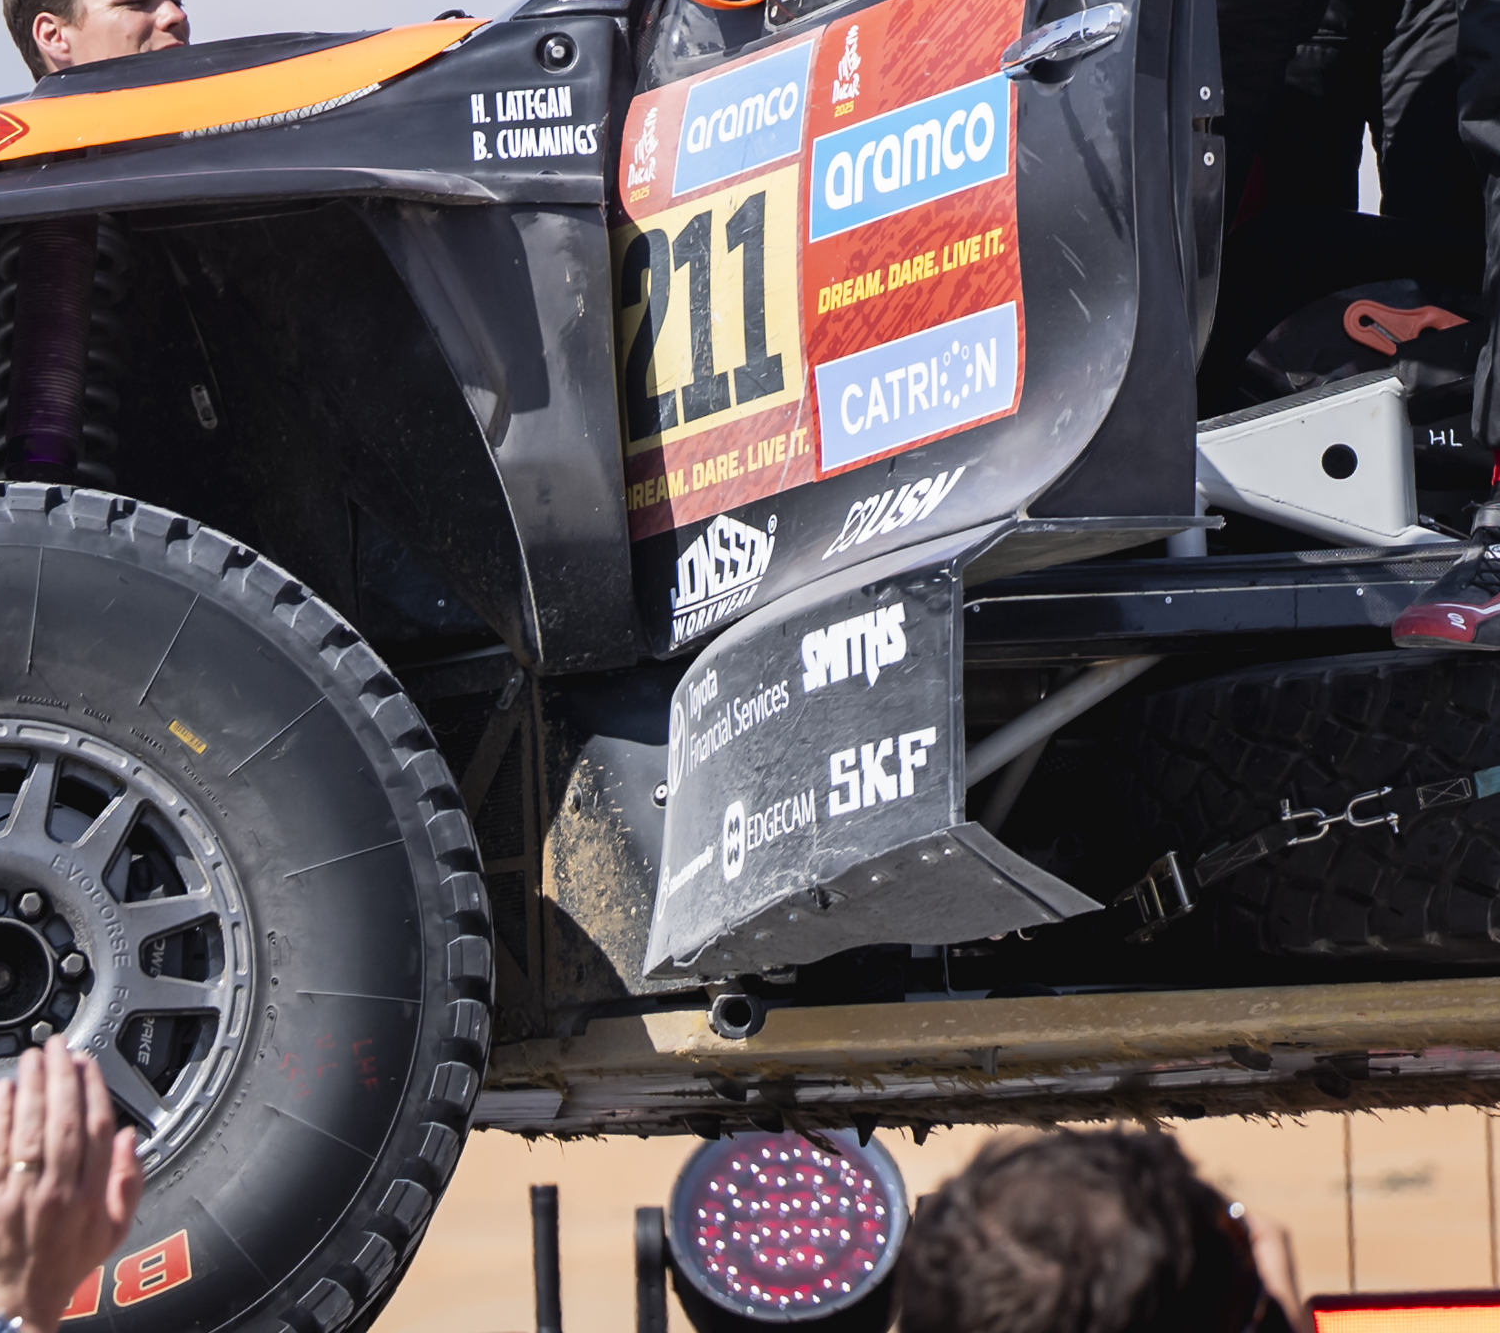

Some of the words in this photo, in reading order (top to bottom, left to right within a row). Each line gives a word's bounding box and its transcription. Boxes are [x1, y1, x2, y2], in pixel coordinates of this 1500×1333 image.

[471, 94, 490, 123] H.
[496, 86, 572, 120] LATEGAN
[686, 82, 799, 154] aramco
[834, 101, 854, 117] 2025
[472, 131, 493, 161] B.
[497, 123, 598, 158] CUMMINGS
[824, 101, 994, 210] aramco
[817, 273, 885, 314] DREAM.
[887, 252, 939, 293] DARE.
[941, 236, 981, 275] LIVE
[981, 227, 1005, 259] IT.
[620, 191, 784, 442] 211
[840, 338, 997, 436] CATRION
[691, 449, 744, 490] DARE.
[747, 434, 786, 476] LIVE
[1429, 429, 1463, 447] HL
[672, 584, 758, 643] WORKWEAR
[802, 602, 907, 693] SMITHS
[689, 667, 718, 722] Toyota
[689, 702, 734, 773] Financial
[733, 679, 790, 737] Services
[829, 726, 936, 817] SKF
[747, 788, 817, 852] EDGECAM
[52, 854, 132, 970] EVOCORSE
